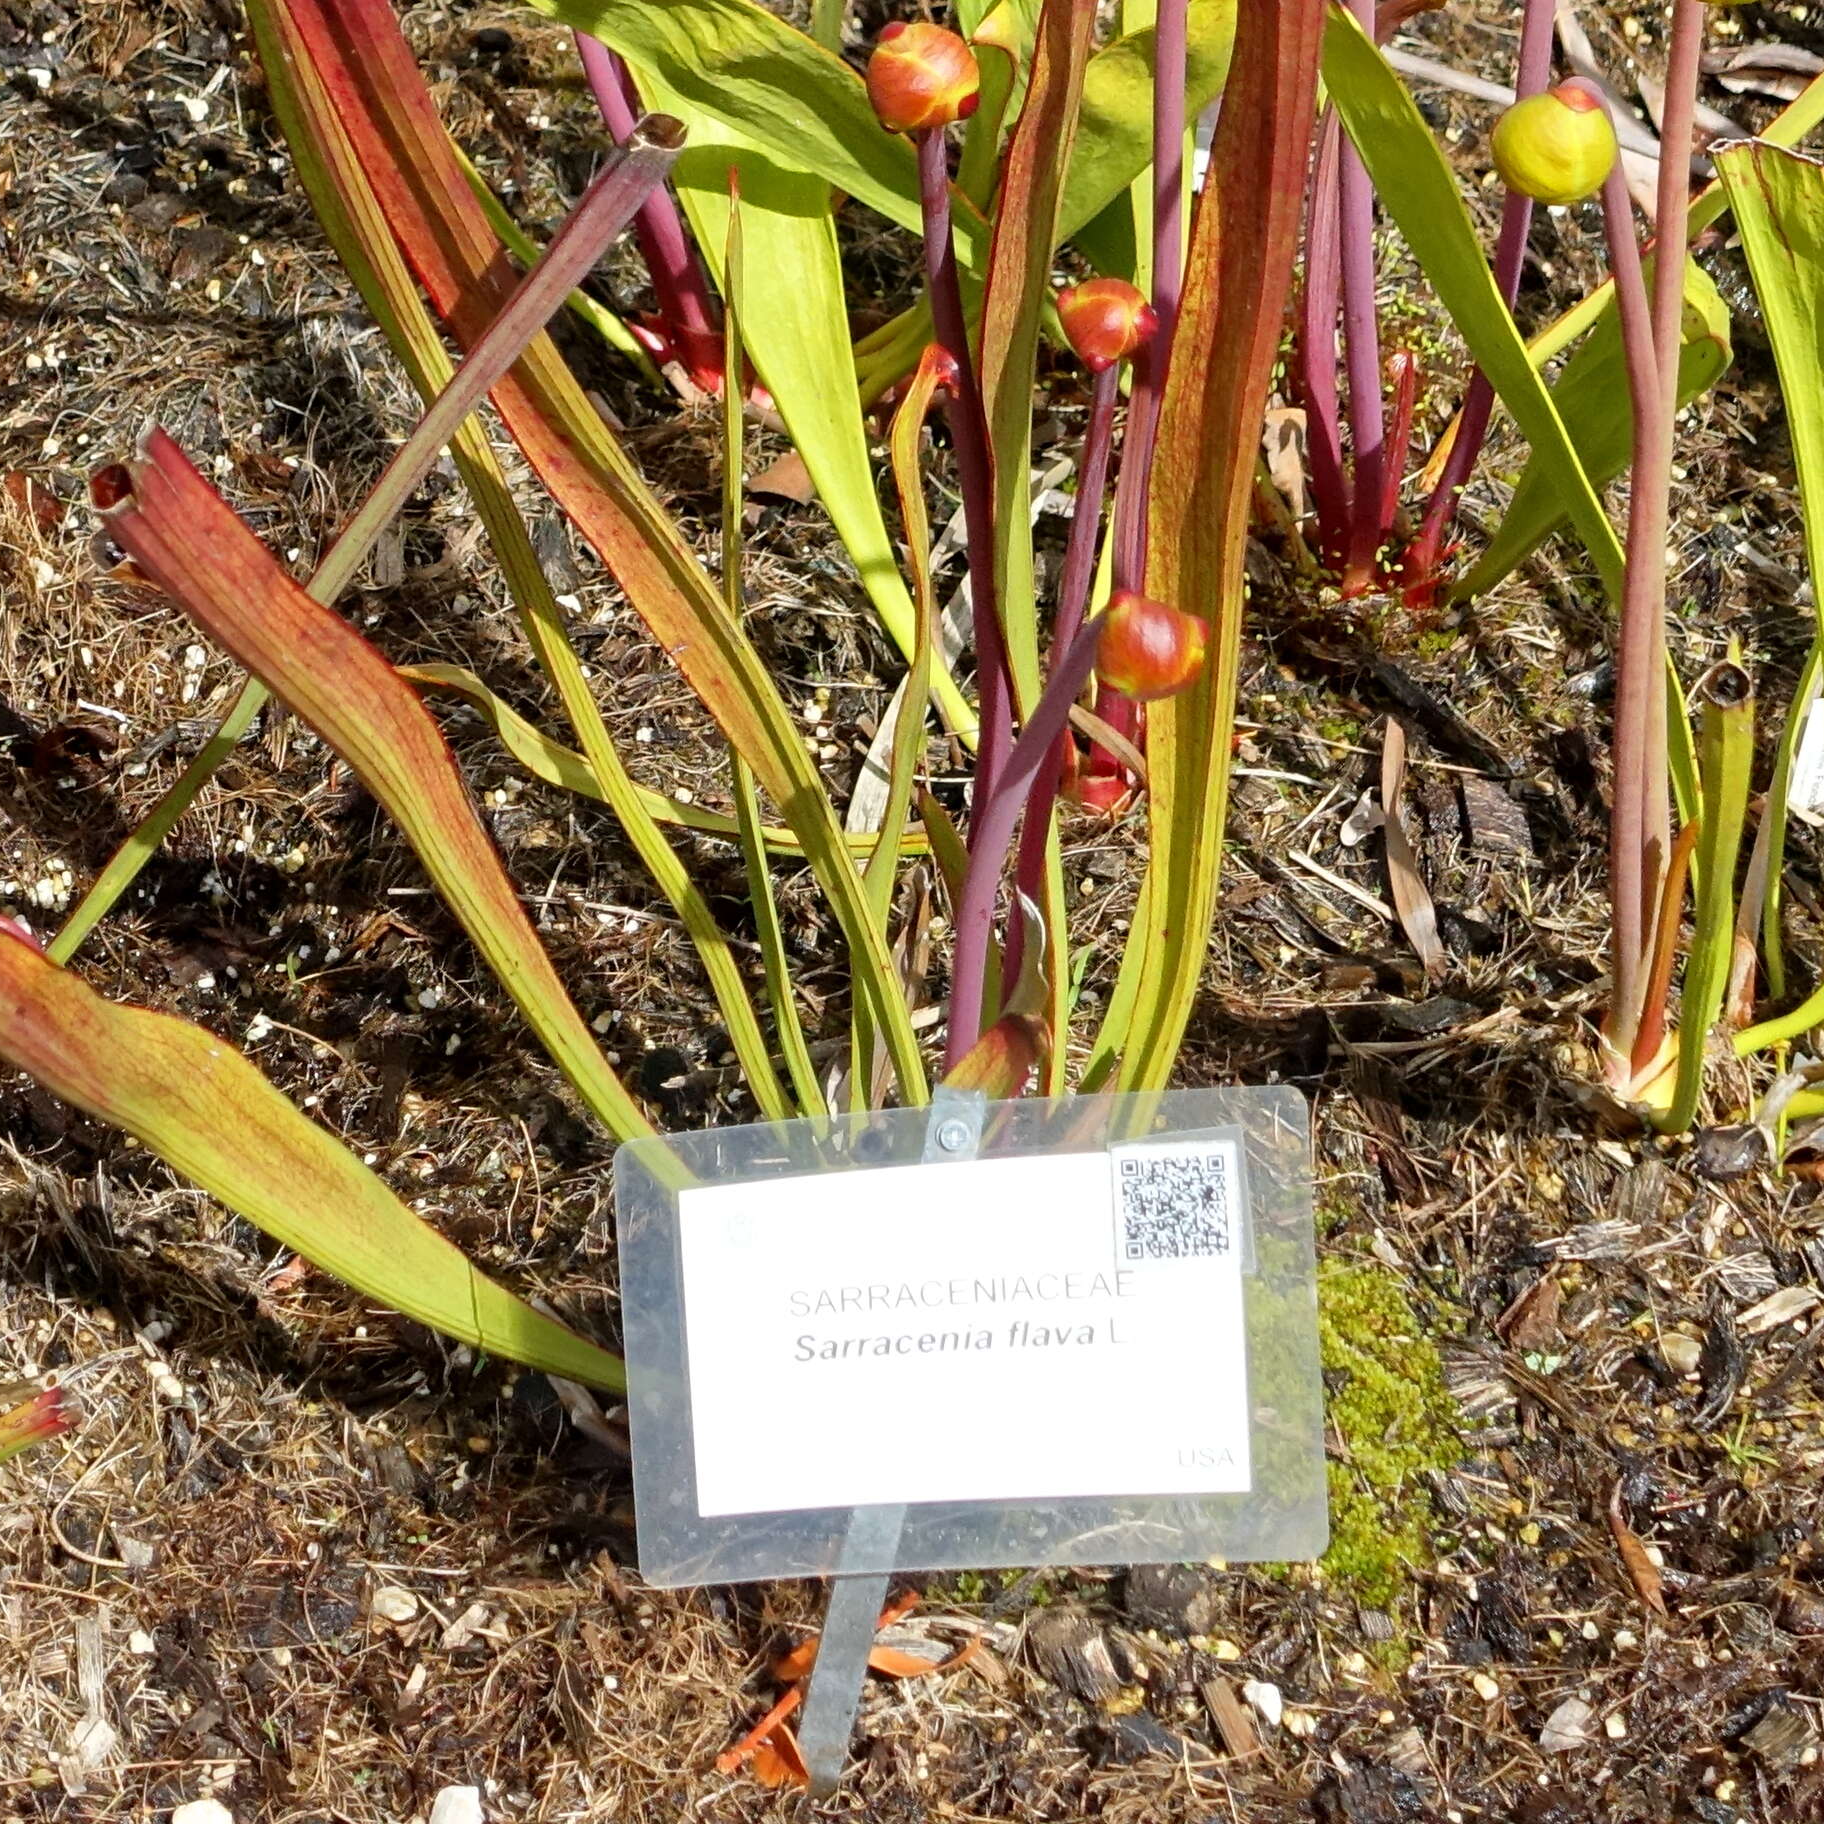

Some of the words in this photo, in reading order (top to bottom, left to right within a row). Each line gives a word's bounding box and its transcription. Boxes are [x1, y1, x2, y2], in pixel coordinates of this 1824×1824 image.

[789, 1270, 1136, 1317] SARRACENIACEAE
[794, 1324, 993, 1362] Sarracenia
[1009, 1321, 1096, 1348] flava
